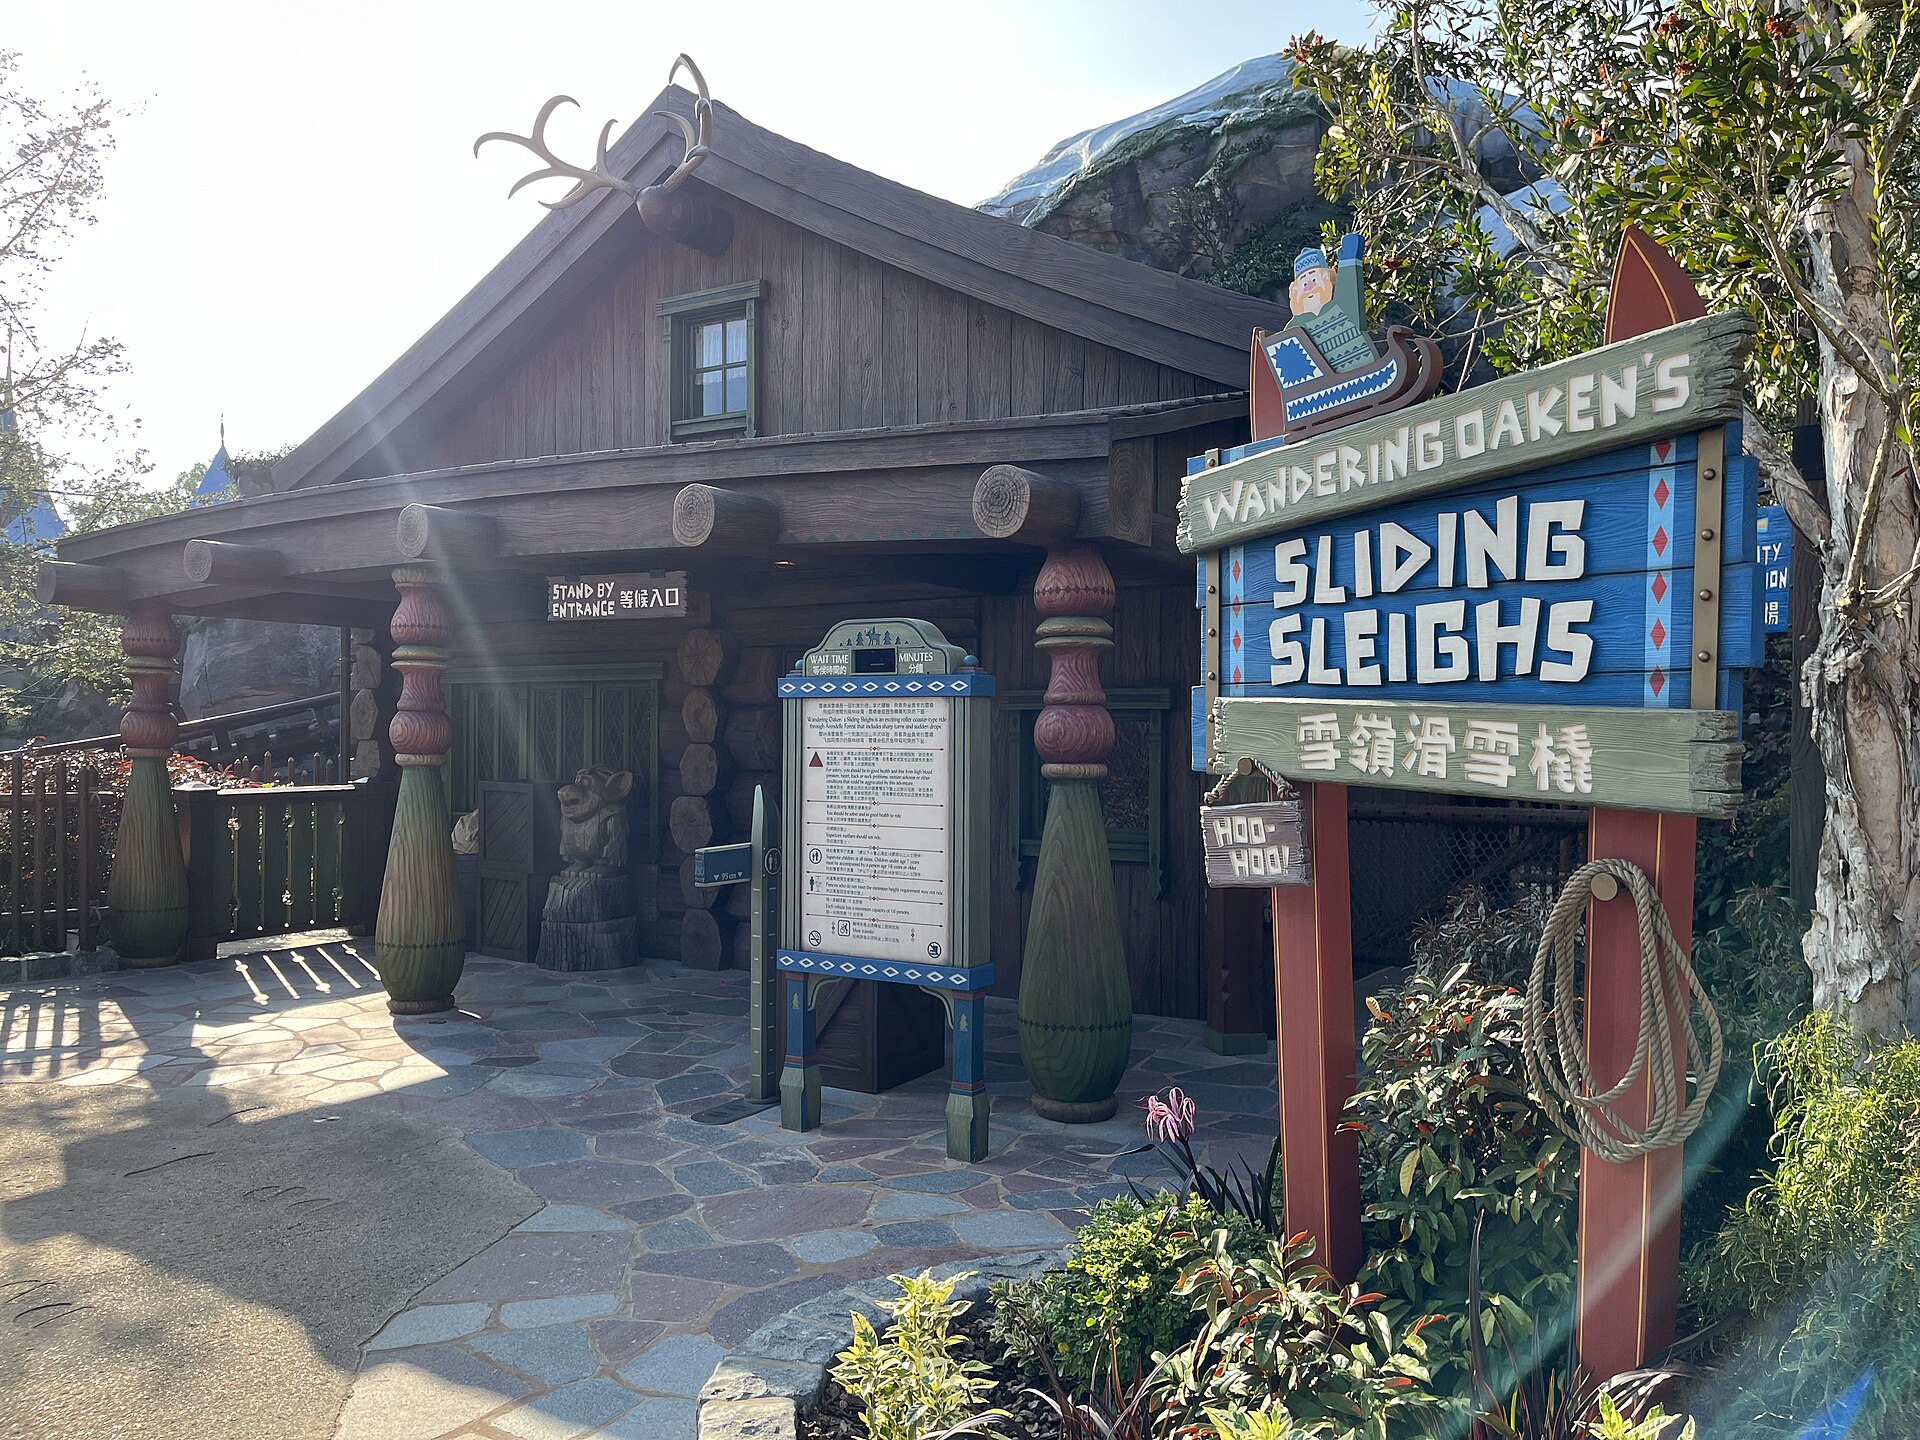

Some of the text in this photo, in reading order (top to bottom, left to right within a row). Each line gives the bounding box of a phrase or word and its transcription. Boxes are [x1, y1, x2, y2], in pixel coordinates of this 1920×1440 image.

[1201, 352, 1692, 533] WANDERING OAKEN'S
[1273, 494, 1587, 610] SLIDING
[552, 582, 615, 601] STAND BY
[619, 588, 679, 609] 等候入口
[552, 600, 615, 618] ENTRANCE
[1269, 597, 1595, 687] SLEIGHS
[809, 654, 849, 664] WAIT TIME
[899, 652, 933, 662] MINUTES
[1295, 713, 1593, 796] 雪嶺滑雪橇
[1213, 815, 1276, 848] HOO-
[1229, 845, 1290, 878] HOO!
[721, 872, 728, 880] 95
